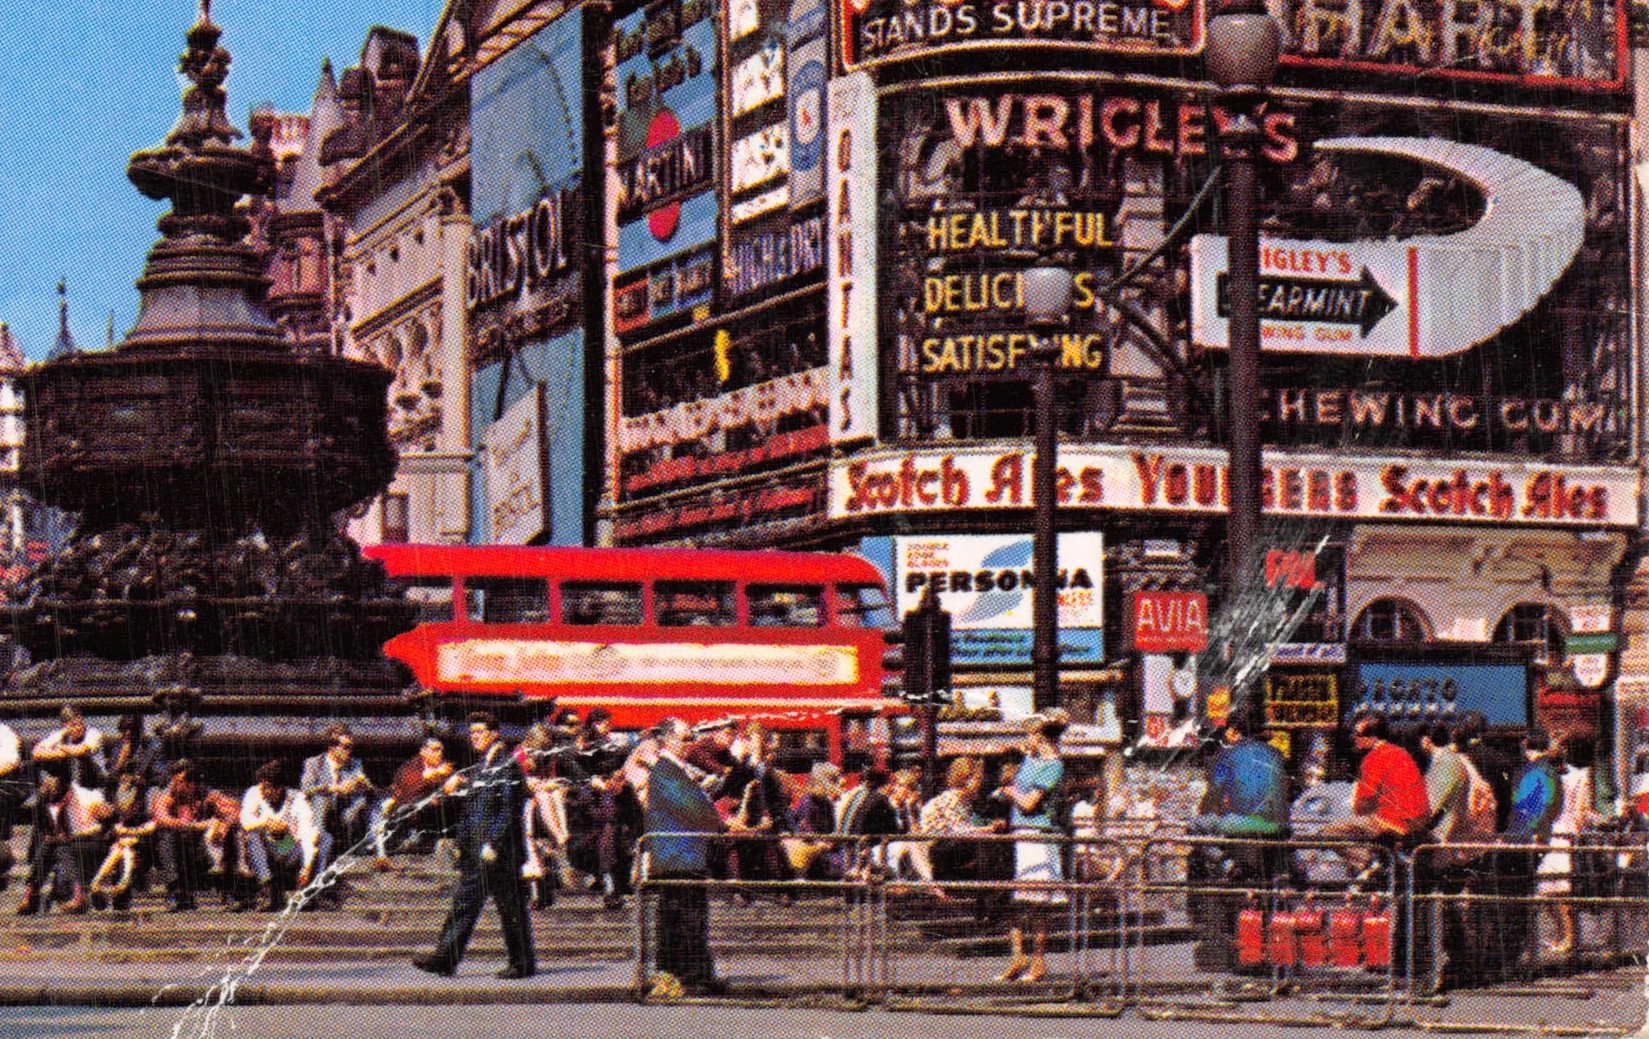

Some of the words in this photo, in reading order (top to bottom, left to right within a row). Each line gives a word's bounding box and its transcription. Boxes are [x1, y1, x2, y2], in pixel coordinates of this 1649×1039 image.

[862, 3, 978, 50] STANDS
[992, 0, 1172, 39] SUPREME
[926, 210, 1114, 251] HEALTHFUL
[1261, 246, 1353, 273] IGLEY'S
[923, 270, 1096, 314] DELICIS
[1258, 282, 1372, 316] EARMINT
[921, 331, 1105, 373] SATISFNG
[1263, 325, 1304, 341] WING
[1500, 396, 1608, 433] GUM
[1130, 451, 1356, 513] YOUERS
[1379, 463, 1515, 522] Scotch
[1138, 596, 1205, 635] AVIA
